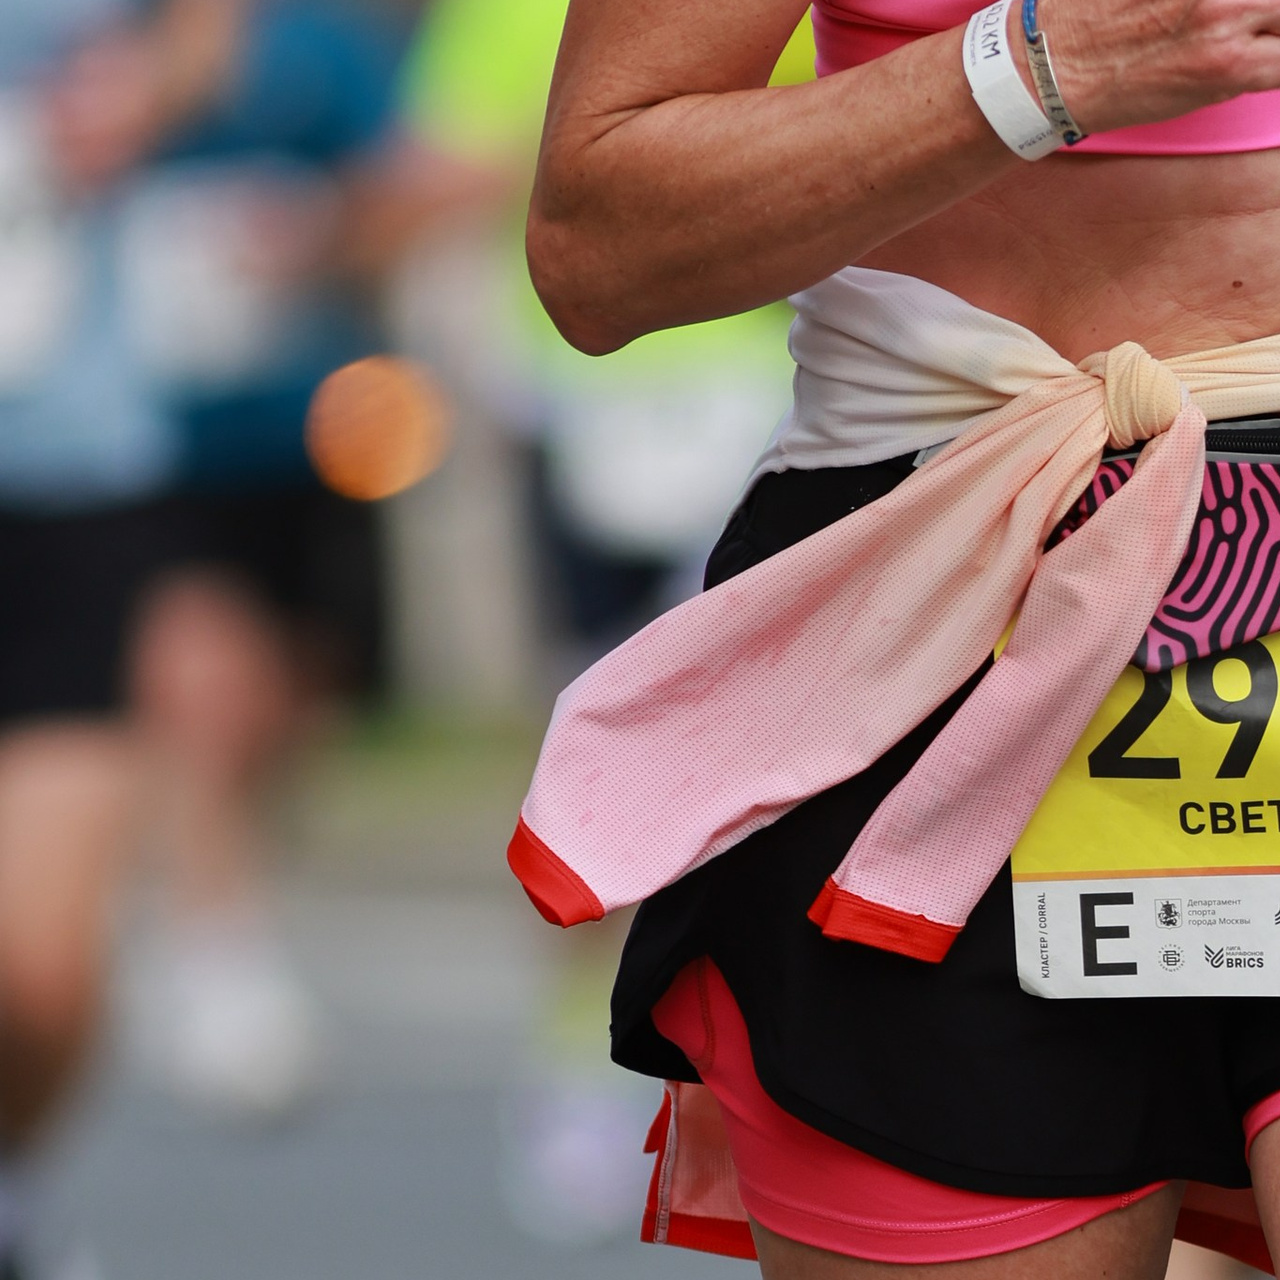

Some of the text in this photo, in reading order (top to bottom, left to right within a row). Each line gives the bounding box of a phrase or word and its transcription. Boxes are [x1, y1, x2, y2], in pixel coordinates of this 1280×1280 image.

[1187, 898, 1241, 907] Департамент
[1038, 892, 1046, 929] CORRAL
[1188, 909, 1216, 917] спорта
[1188, 918, 1217, 926] города
[1079, 891, 1138, 977] E
[1039, 937, 1050, 979] КЛАСТЕР
[1226, 957, 1264, 968] BRICS
